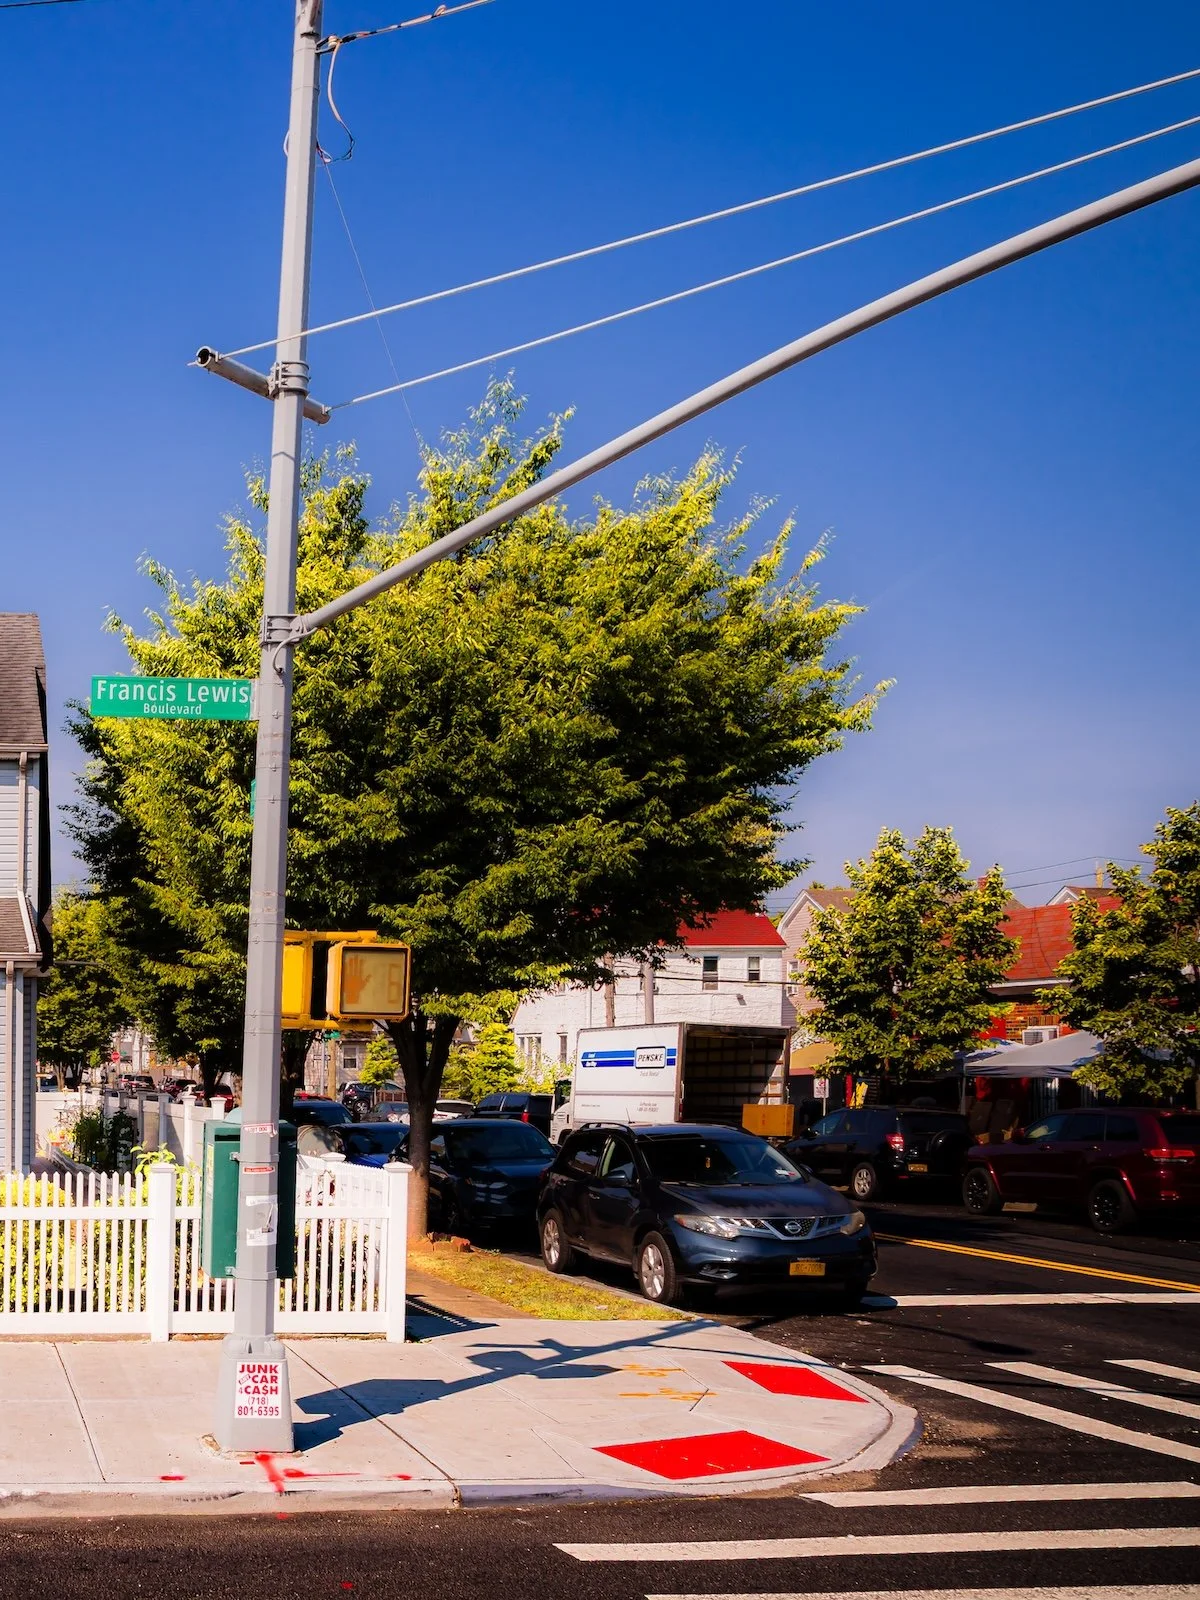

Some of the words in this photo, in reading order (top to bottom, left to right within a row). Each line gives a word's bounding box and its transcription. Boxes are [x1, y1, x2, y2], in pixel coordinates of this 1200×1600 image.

[97, 680, 176, 702] Francis
[188, 681, 249, 703] Lewis
[143, 702, 202, 715] Boulevard
[637, 1053, 664, 1062] PENSKE
[239, 1364, 279, 1374] JUNK
[251, 1374, 278, 1384] CAR
[248, 1396, 268, 1405] (718)
[237, 1405, 279, 1416] 801-6395
